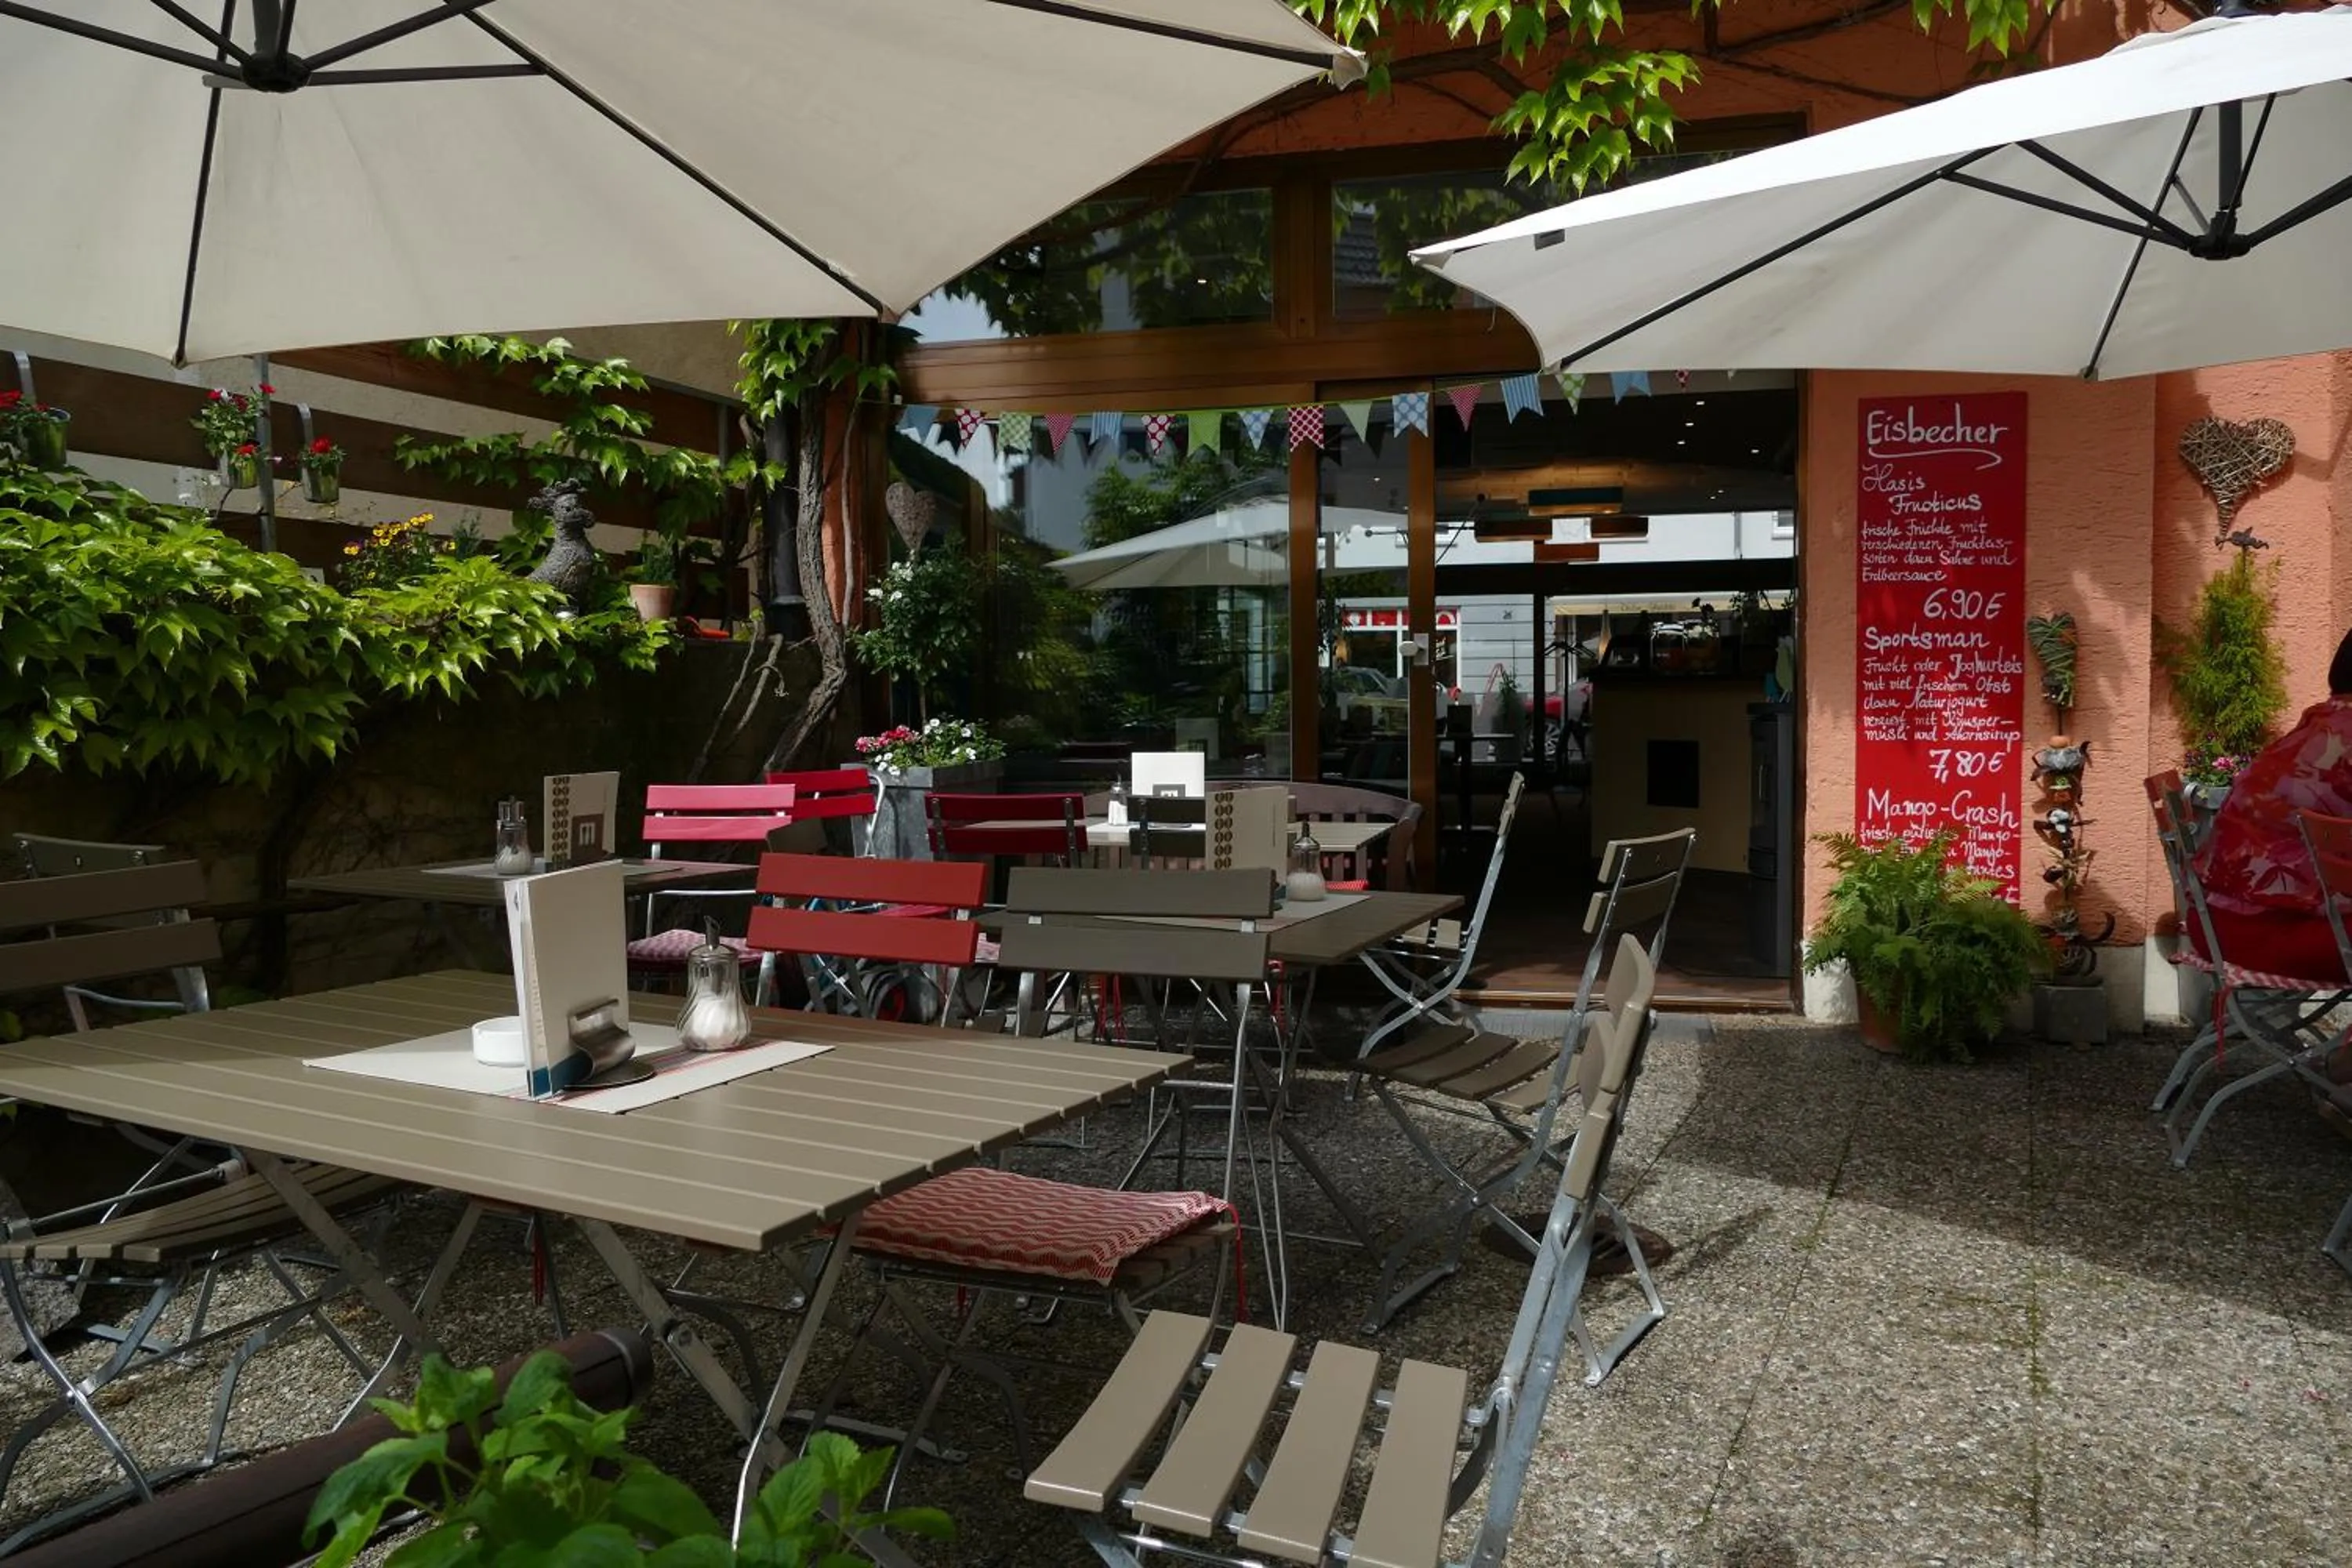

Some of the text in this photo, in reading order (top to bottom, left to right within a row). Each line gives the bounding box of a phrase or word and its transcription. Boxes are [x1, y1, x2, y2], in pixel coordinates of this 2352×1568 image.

[1867, 402, 2009, 445] Eisbecher
[1960, 516, 1987, 534] mit
[1980, 547, 2017, 565] und
[1863, 622, 1991, 655] Sportsman
[1914, 657, 1943, 672] oder
[1863, 677, 1885, 691] mit
[1889, 676, 1911, 690] viel
[1975, 677, 2012, 694] Obst
[1915, 712, 1937, 726] mit
[1914, 726, 1939, 742] und
